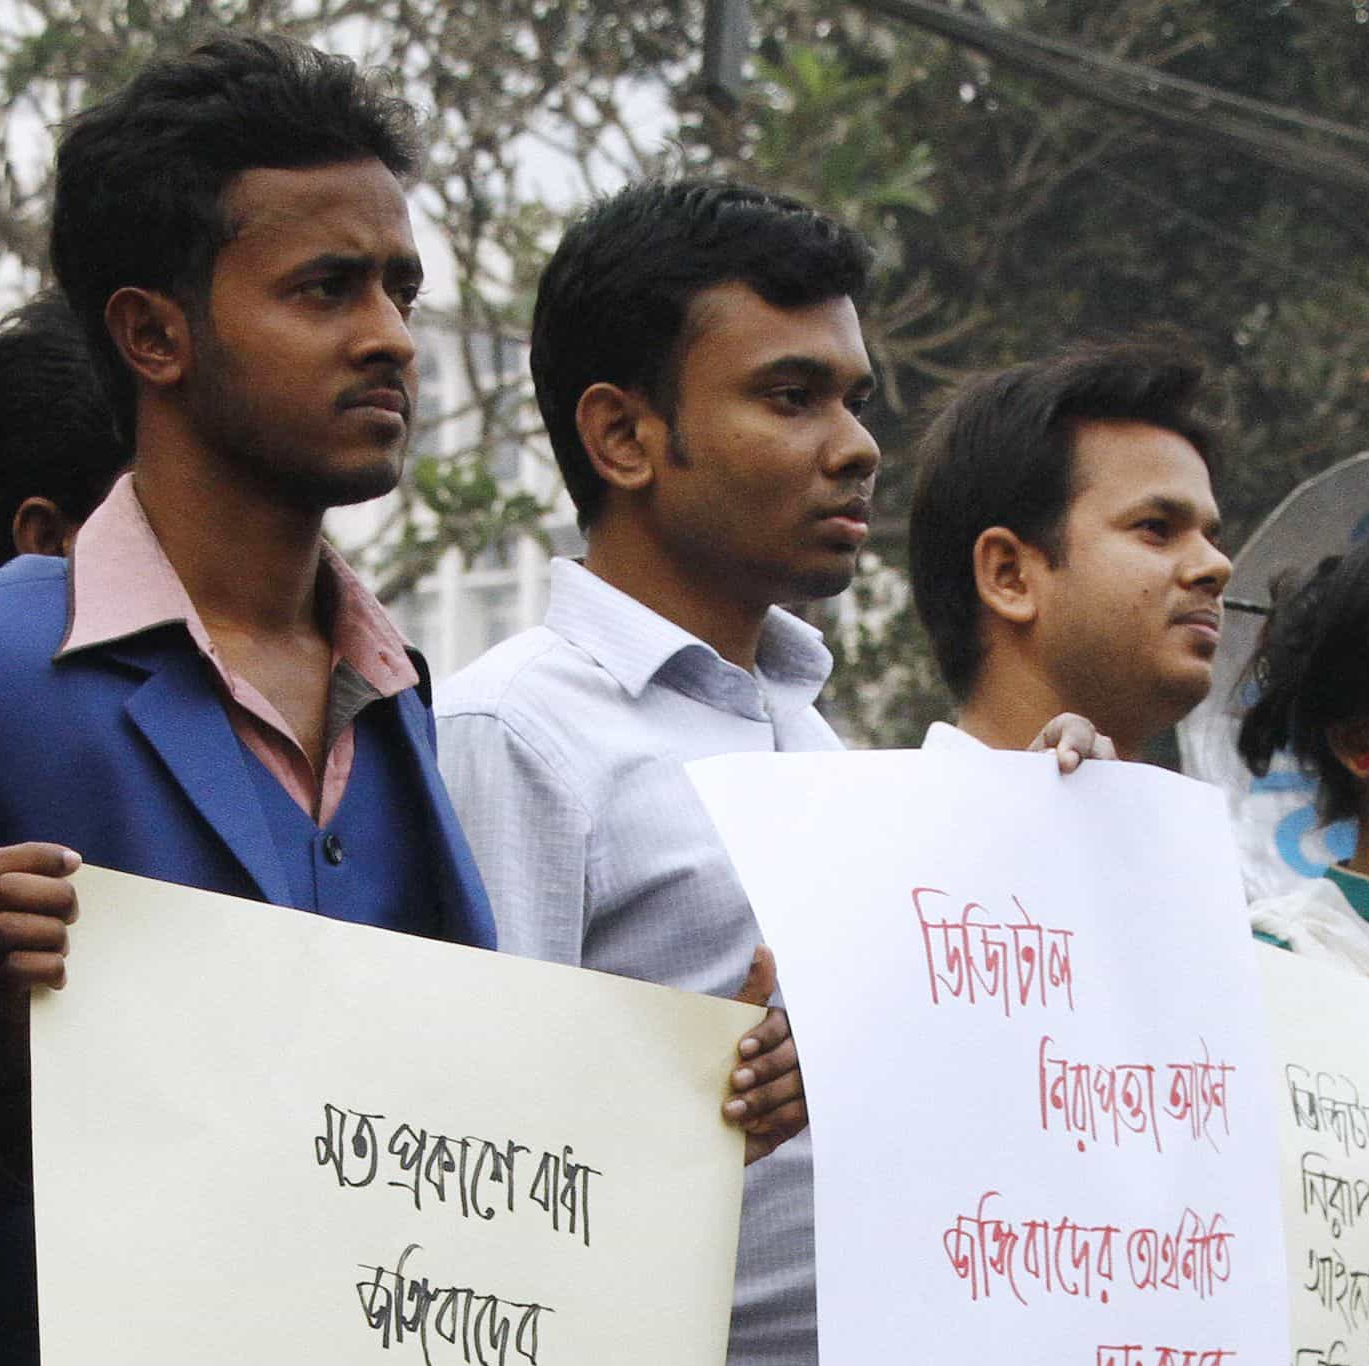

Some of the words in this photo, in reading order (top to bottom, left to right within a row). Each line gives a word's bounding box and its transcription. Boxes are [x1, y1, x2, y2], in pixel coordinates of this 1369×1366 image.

[911, 887, 1074, 1018] ডিজিটাল
[1038, 1035, 1162, 1153] নিরাপত্তা
[314, 1103, 386, 1188] মত
[386, 1123, 533, 1221] প্রকাশে
[526, 1145, 603, 1247] বাধা
